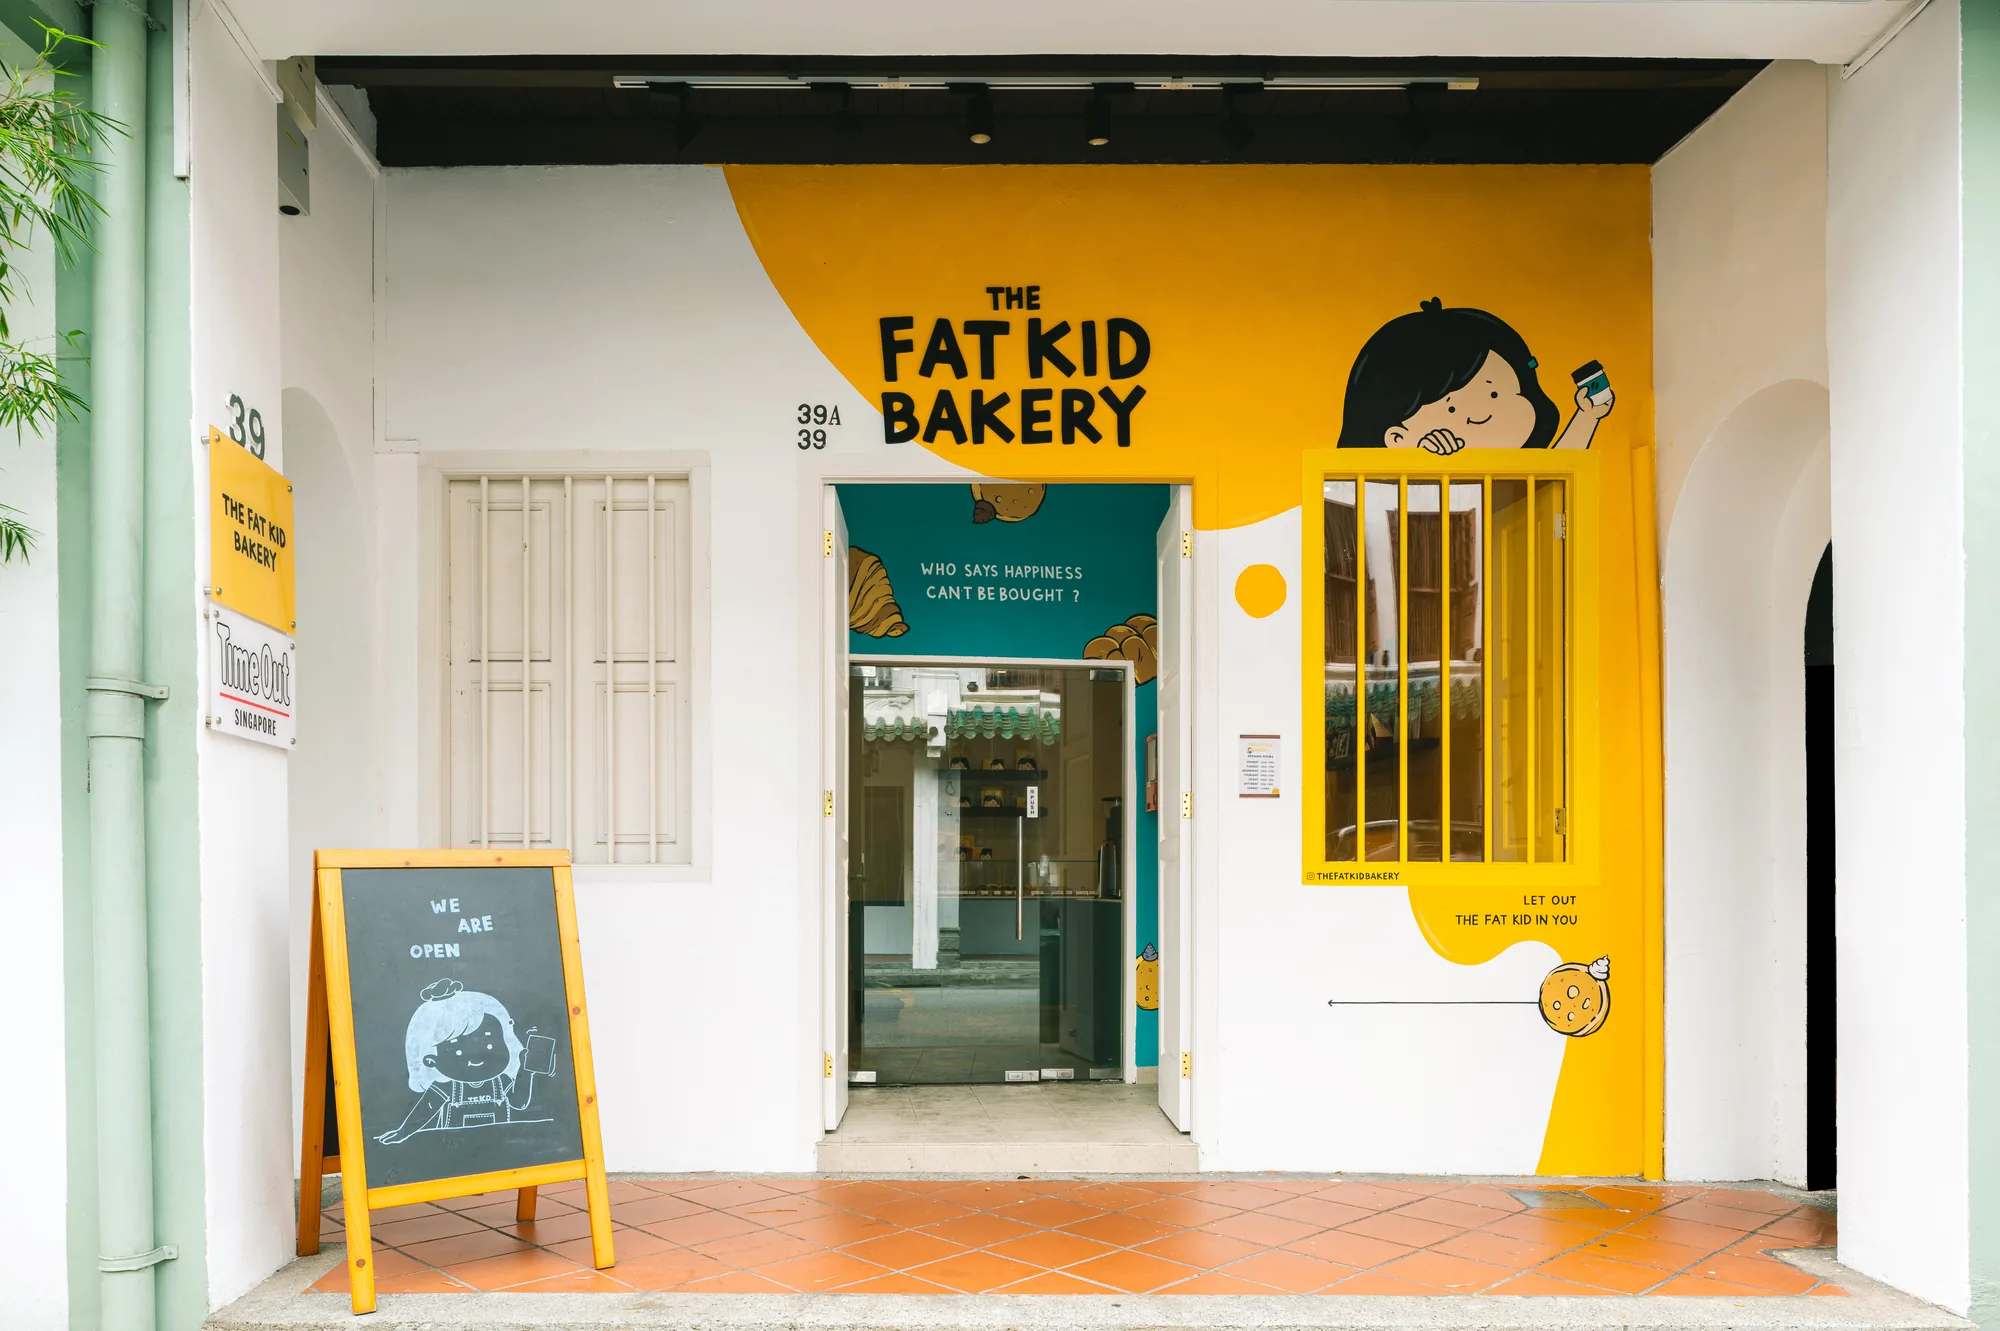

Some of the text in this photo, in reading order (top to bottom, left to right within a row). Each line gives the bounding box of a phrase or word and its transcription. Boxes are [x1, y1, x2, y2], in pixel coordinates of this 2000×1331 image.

[986, 286, 1041, 311] THE
[879, 316, 1151, 382] FAT KID
[797, 403, 842, 425] 39A
[881, 384, 1147, 448] BAKERY
[226, 392, 265, 461] 39
[797, 429, 827, 450] 39
[222, 493, 286, 548] THE FAT KID
[234, 530, 277, 572] BAKERY
[921, 563, 1083, 579] WHO SAYS HAPPINESS
[977, 586, 995, 601] BE
[1000, 587, 1063, 602] BOUGHT
[216, 621, 290, 706] Time Out
[234, 708, 277, 736] SINGAPORE
[1317, 872, 1400, 881] THEFATKIDBAKERY
[430, 898, 460, 914] WE
[1523, 895, 1577, 905] LET OUT
[457, 915, 494, 933] ARE
[1455, 913, 1578, 926] THE FAT KID IN YOU
[410, 943, 460, 959] OPEN
